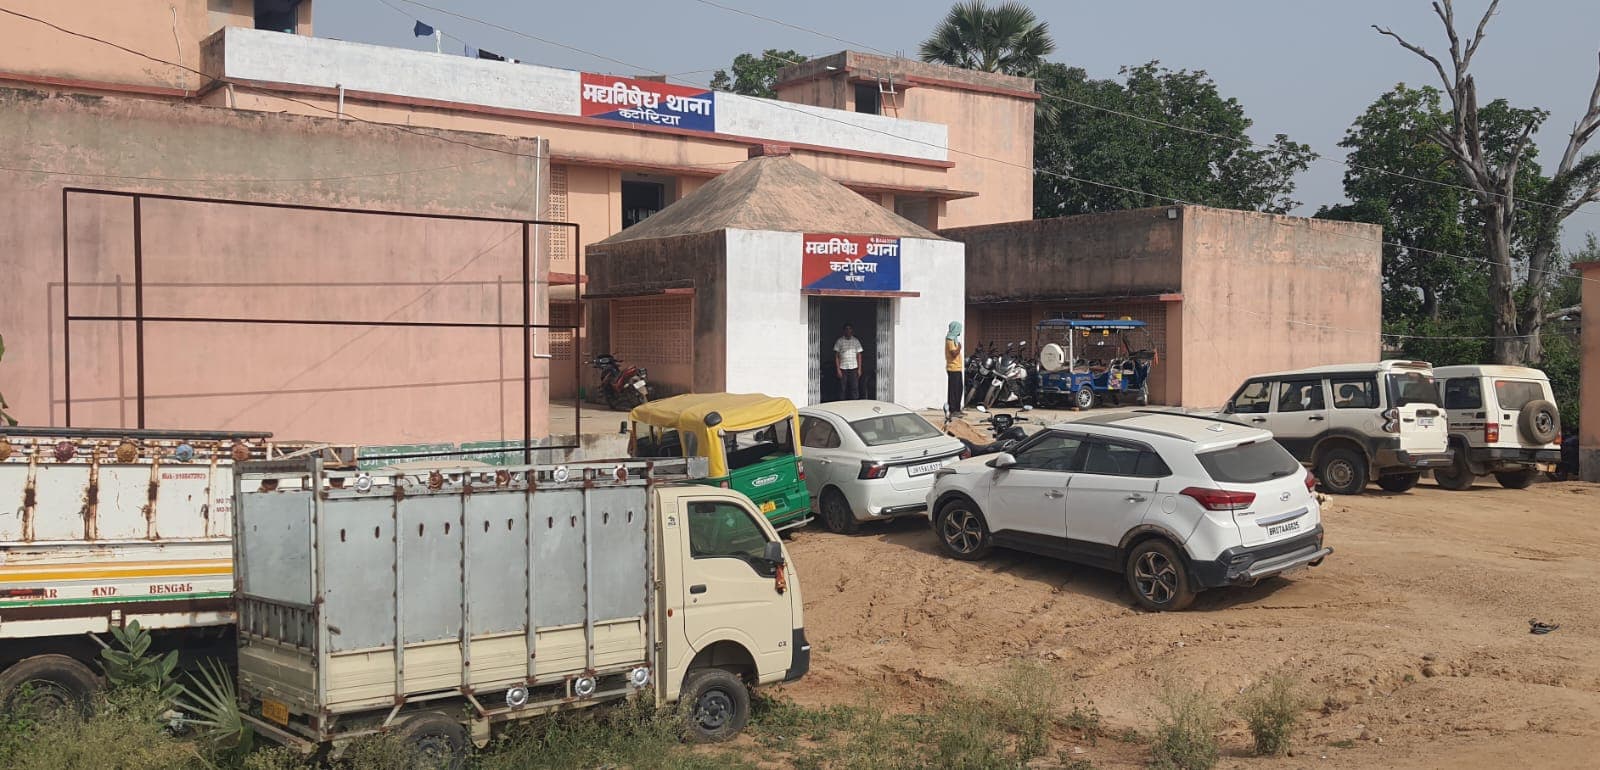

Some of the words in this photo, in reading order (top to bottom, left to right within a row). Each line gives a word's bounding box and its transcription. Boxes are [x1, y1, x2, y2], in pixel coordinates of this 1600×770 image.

[583, 82, 661, 109] मद्यनिषेध
[666, 94, 712, 115] थाना
[619, 107, 681, 125] कटोरिया
[805, 238, 858, 255] मद्यनिषेध
[866, 243, 898, 256] थाना
[829, 258, 878, 273] कटोरिया
[92, 586, 117, 597] AND
[150, 583, 193, 594] BENGAL
